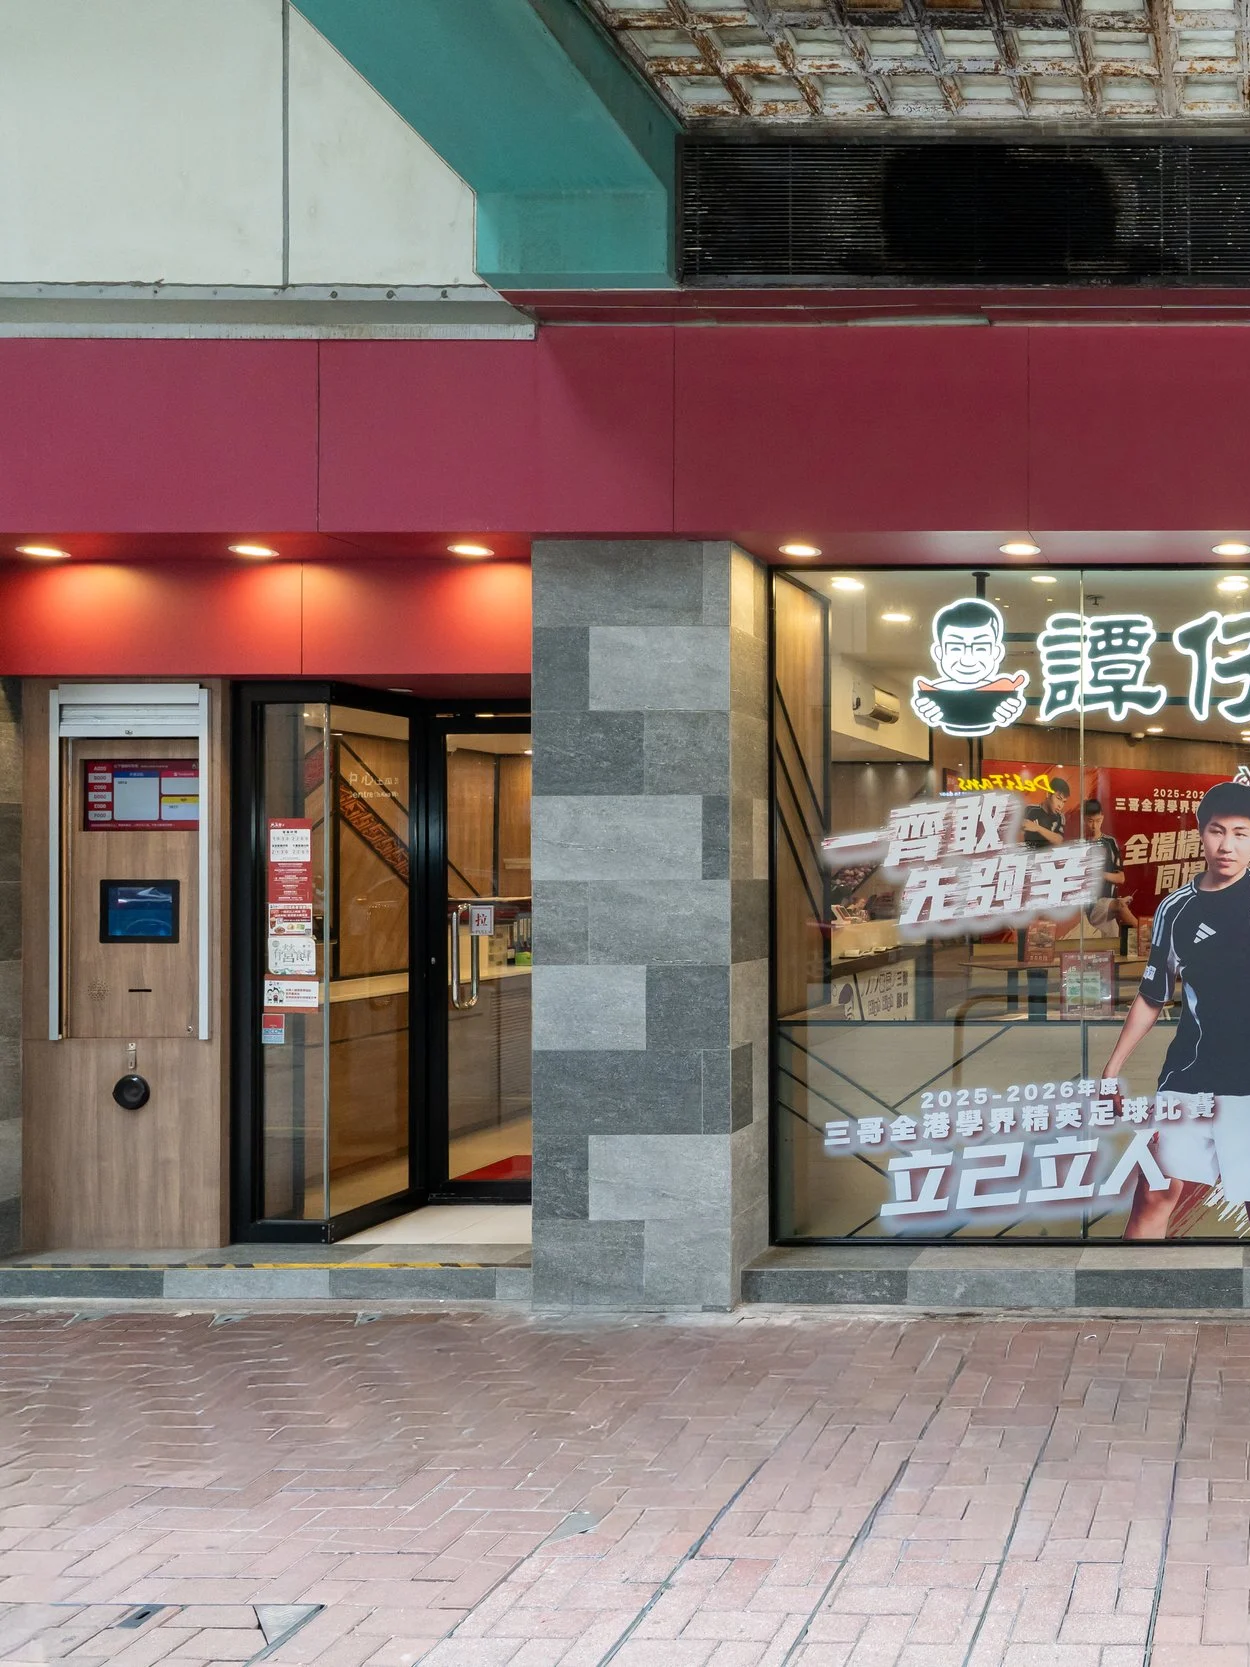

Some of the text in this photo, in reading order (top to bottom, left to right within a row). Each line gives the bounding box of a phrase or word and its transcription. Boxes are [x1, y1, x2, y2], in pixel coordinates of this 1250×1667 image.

[1123, 829, 1206, 866] 全場精
[475, 913, 488, 927] 拉
[921, 1077, 1119, 1109] 2025-2026年度
[824, 1092, 1216, 1147] 三哥全港學界精英足球比賽
[879, 1129, 1172, 1217] 立己立人
